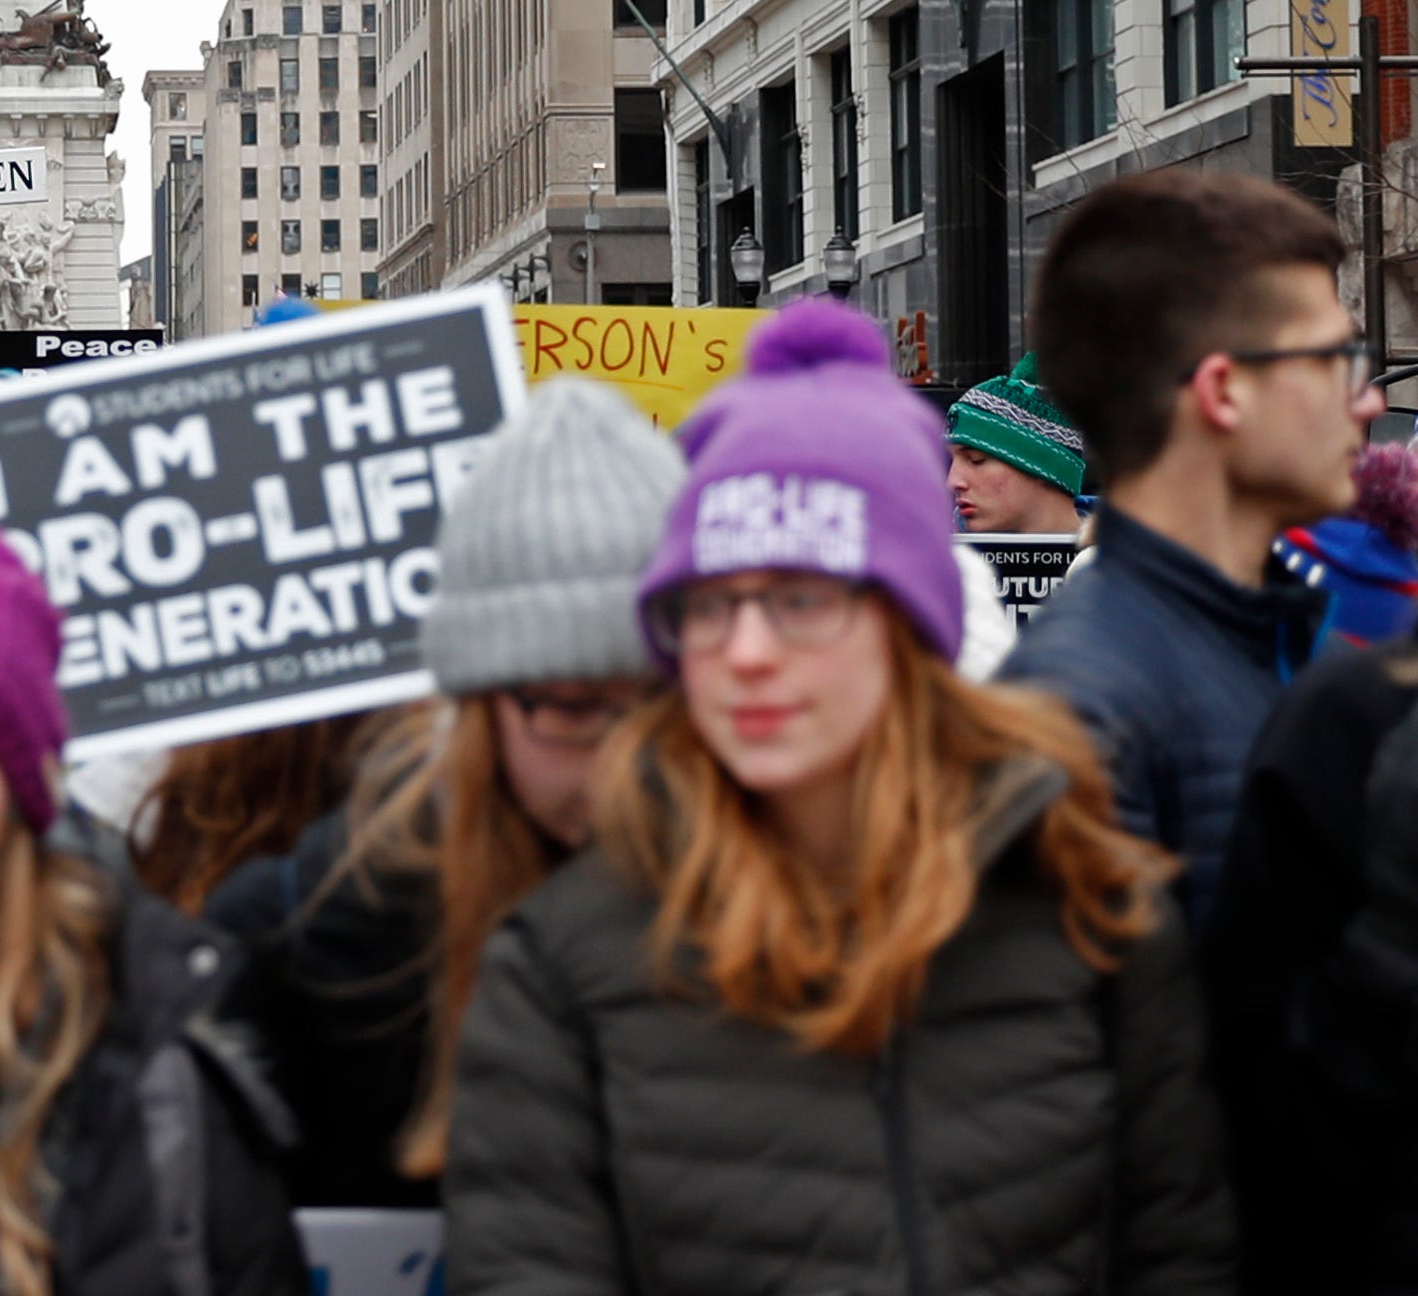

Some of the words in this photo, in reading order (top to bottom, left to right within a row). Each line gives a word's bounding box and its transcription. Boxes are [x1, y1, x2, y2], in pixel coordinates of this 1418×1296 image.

[1299, 68, 1338, 127] Th
[35, 335, 158, 357] Peace
[93, 367, 247, 426] STUDENTS
[246, 352, 313, 396] FOR
[313, 341, 379, 382] LIFE
[54, 412, 217, 505] AM
[254, 364, 464, 462] THE
[983, 552, 1030, 564] DENTS
[1033, 552, 1063, 564] FOR
[57, 547, 441, 688] ENERATIO
